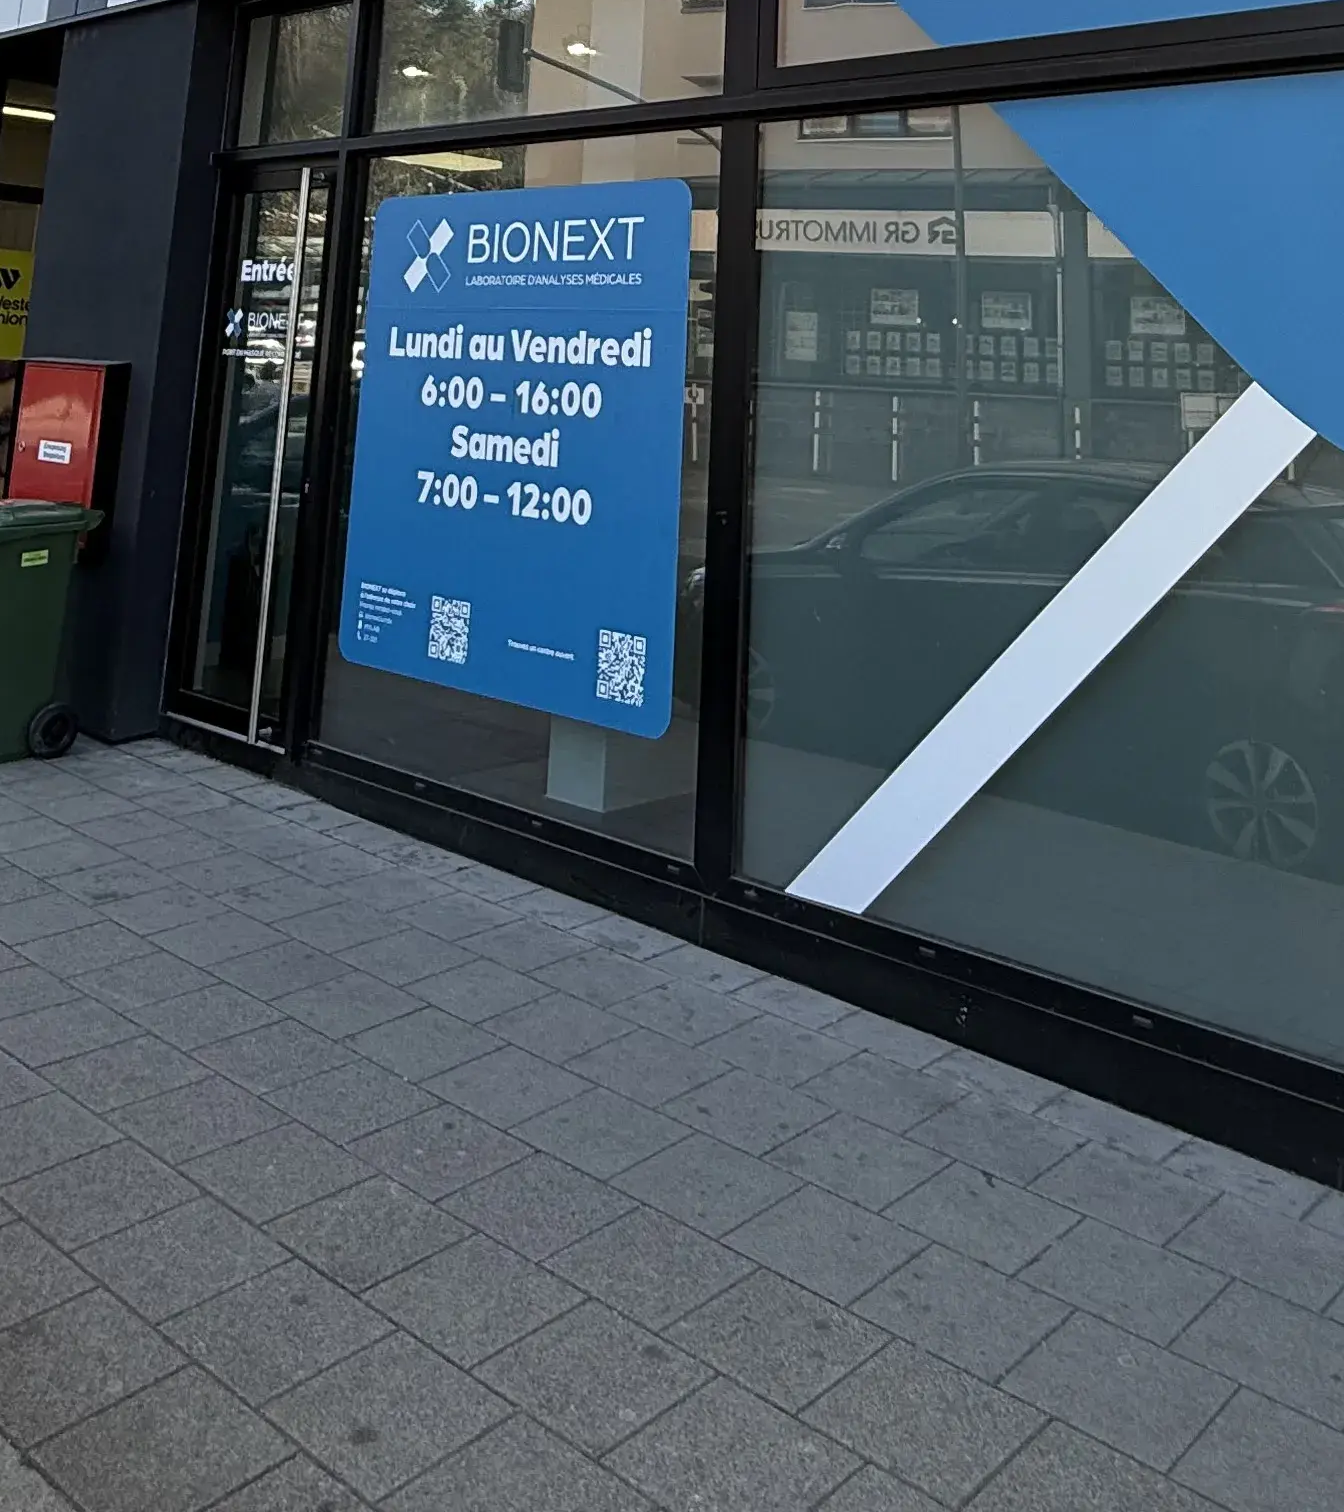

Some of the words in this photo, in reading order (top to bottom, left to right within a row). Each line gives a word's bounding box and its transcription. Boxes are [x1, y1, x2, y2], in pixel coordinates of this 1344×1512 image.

[466, 216, 645, 264] BIONEXT
[465, 273, 527, 286] LABORATOIRE
[527, 273, 584, 286] D'ANALYSES
[585, 272, 643, 285] MÉDICALES
[389, 324, 464, 359] Lundi
[468, 332, 505, 361] au
[511, 327, 652, 367] Vendredi
[421, 374, 484, 410] 6:00
[515, 380, 602, 418] 16:00
[451, 424, 560, 468] Samedi
[417, 470, 478, 509] 7:00
[506, 481, 592, 526] 12:00
